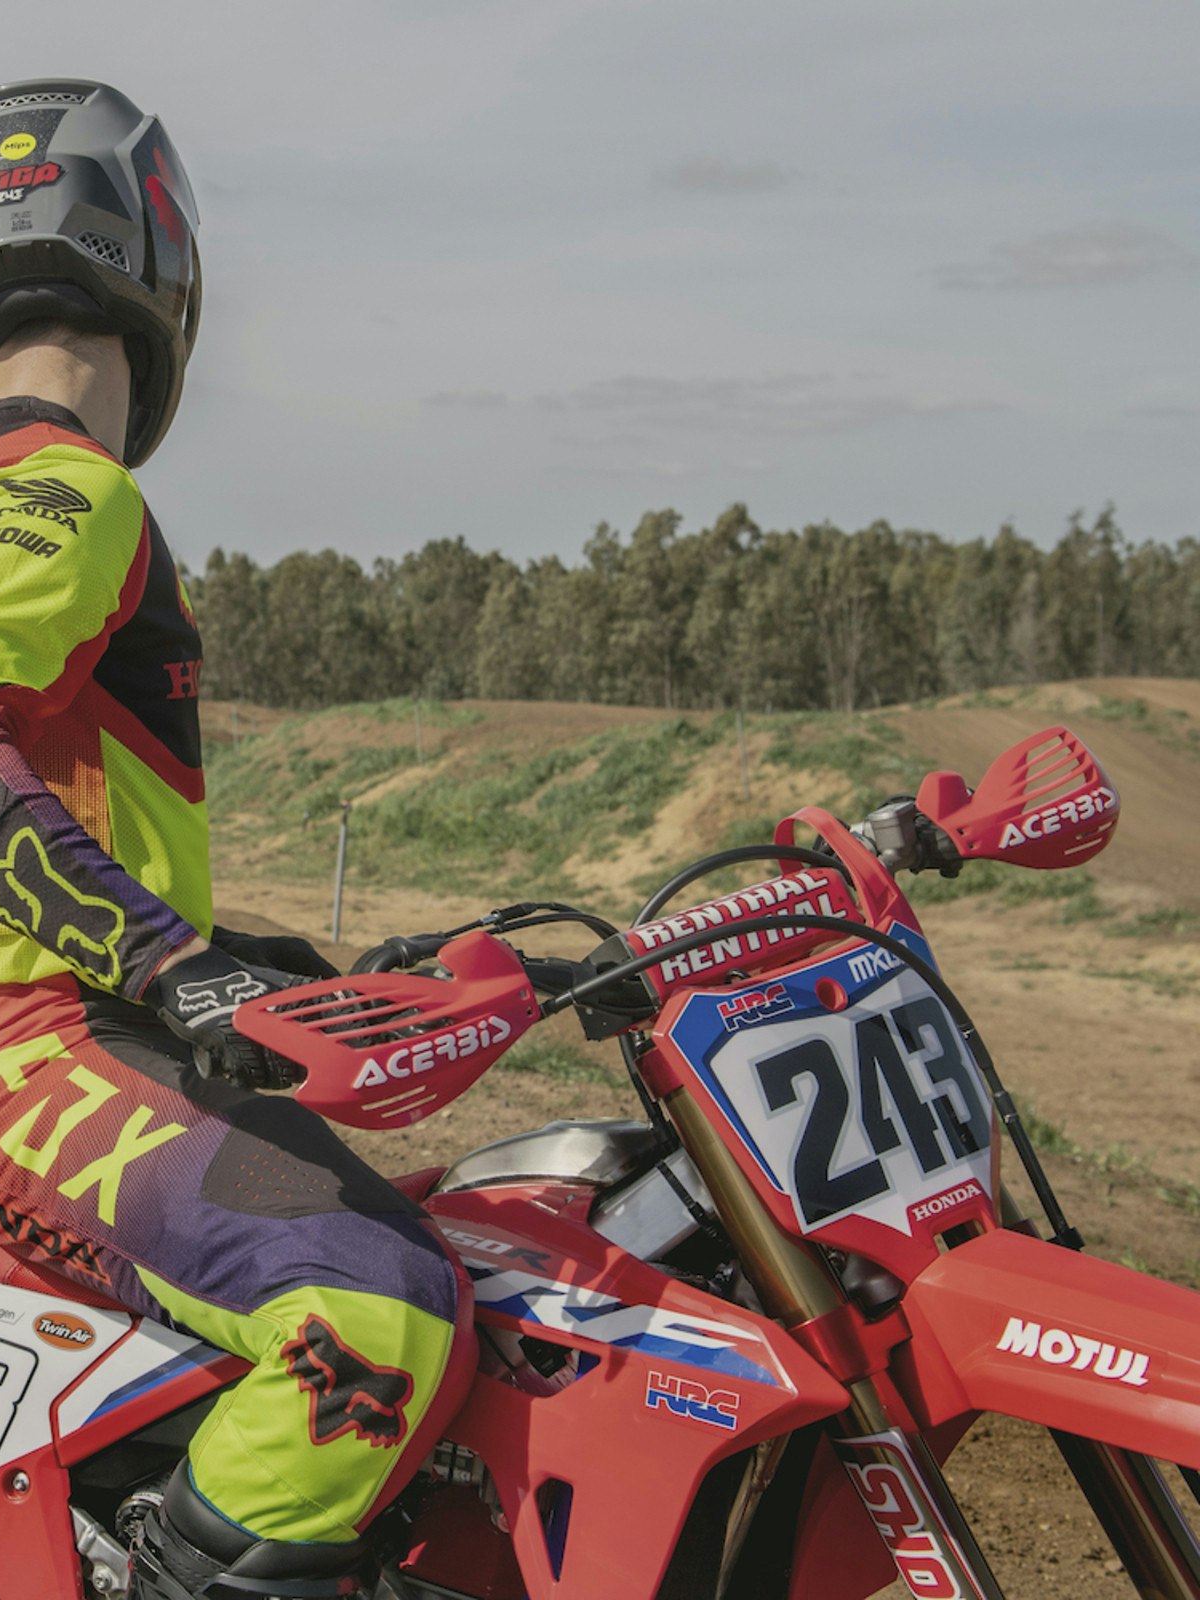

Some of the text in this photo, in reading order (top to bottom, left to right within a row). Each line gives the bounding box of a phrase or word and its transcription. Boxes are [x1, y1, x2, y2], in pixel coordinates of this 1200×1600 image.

[635, 869, 829, 950] RENTHAL
[660, 893, 848, 984] RENTHAL
[716, 983, 796, 1033] HRC
[753, 996, 991, 1226] 243
[911, 1183, 983, 1222] HONDA
[37, 1317, 94, 1345] Twin Air
[995, 1316, 1150, 1387] MOTUL
[645, 1370, 740, 1431] HRC
